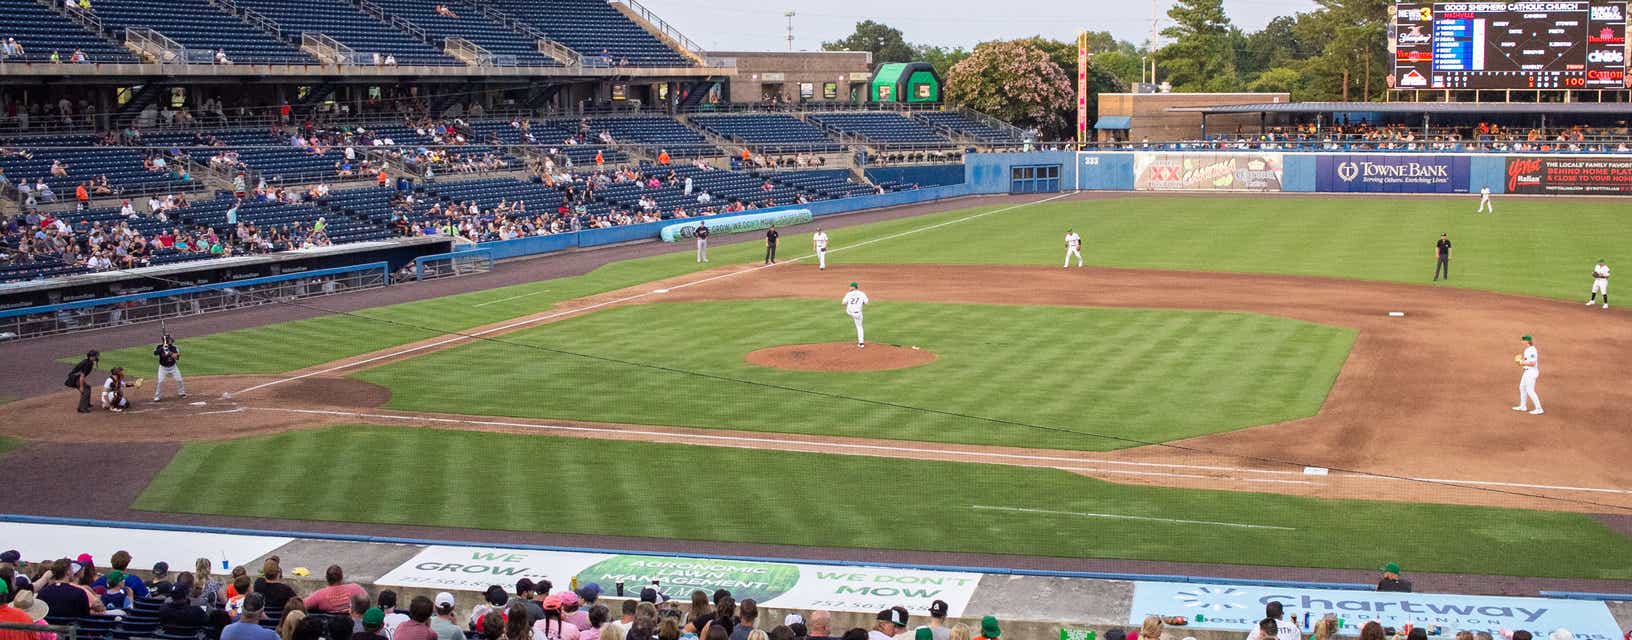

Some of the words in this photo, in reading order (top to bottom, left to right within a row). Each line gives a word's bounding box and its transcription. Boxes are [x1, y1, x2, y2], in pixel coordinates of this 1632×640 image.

[1588, 70, 1623, 79] Canon
[471, 551, 529, 563] WE
[630, 560, 769, 574] AGRONOMIC
[600, 573, 770, 588] MANAGEMENT
[658, 569, 725, 579] LAWN
[816, 571, 868, 582] WE
[874, 574, 973, 587] DON'T
[835, 585, 944, 598] MOW
[1259, 593, 1549, 623] Chartway
[1417, 616, 1502, 626] UNION
